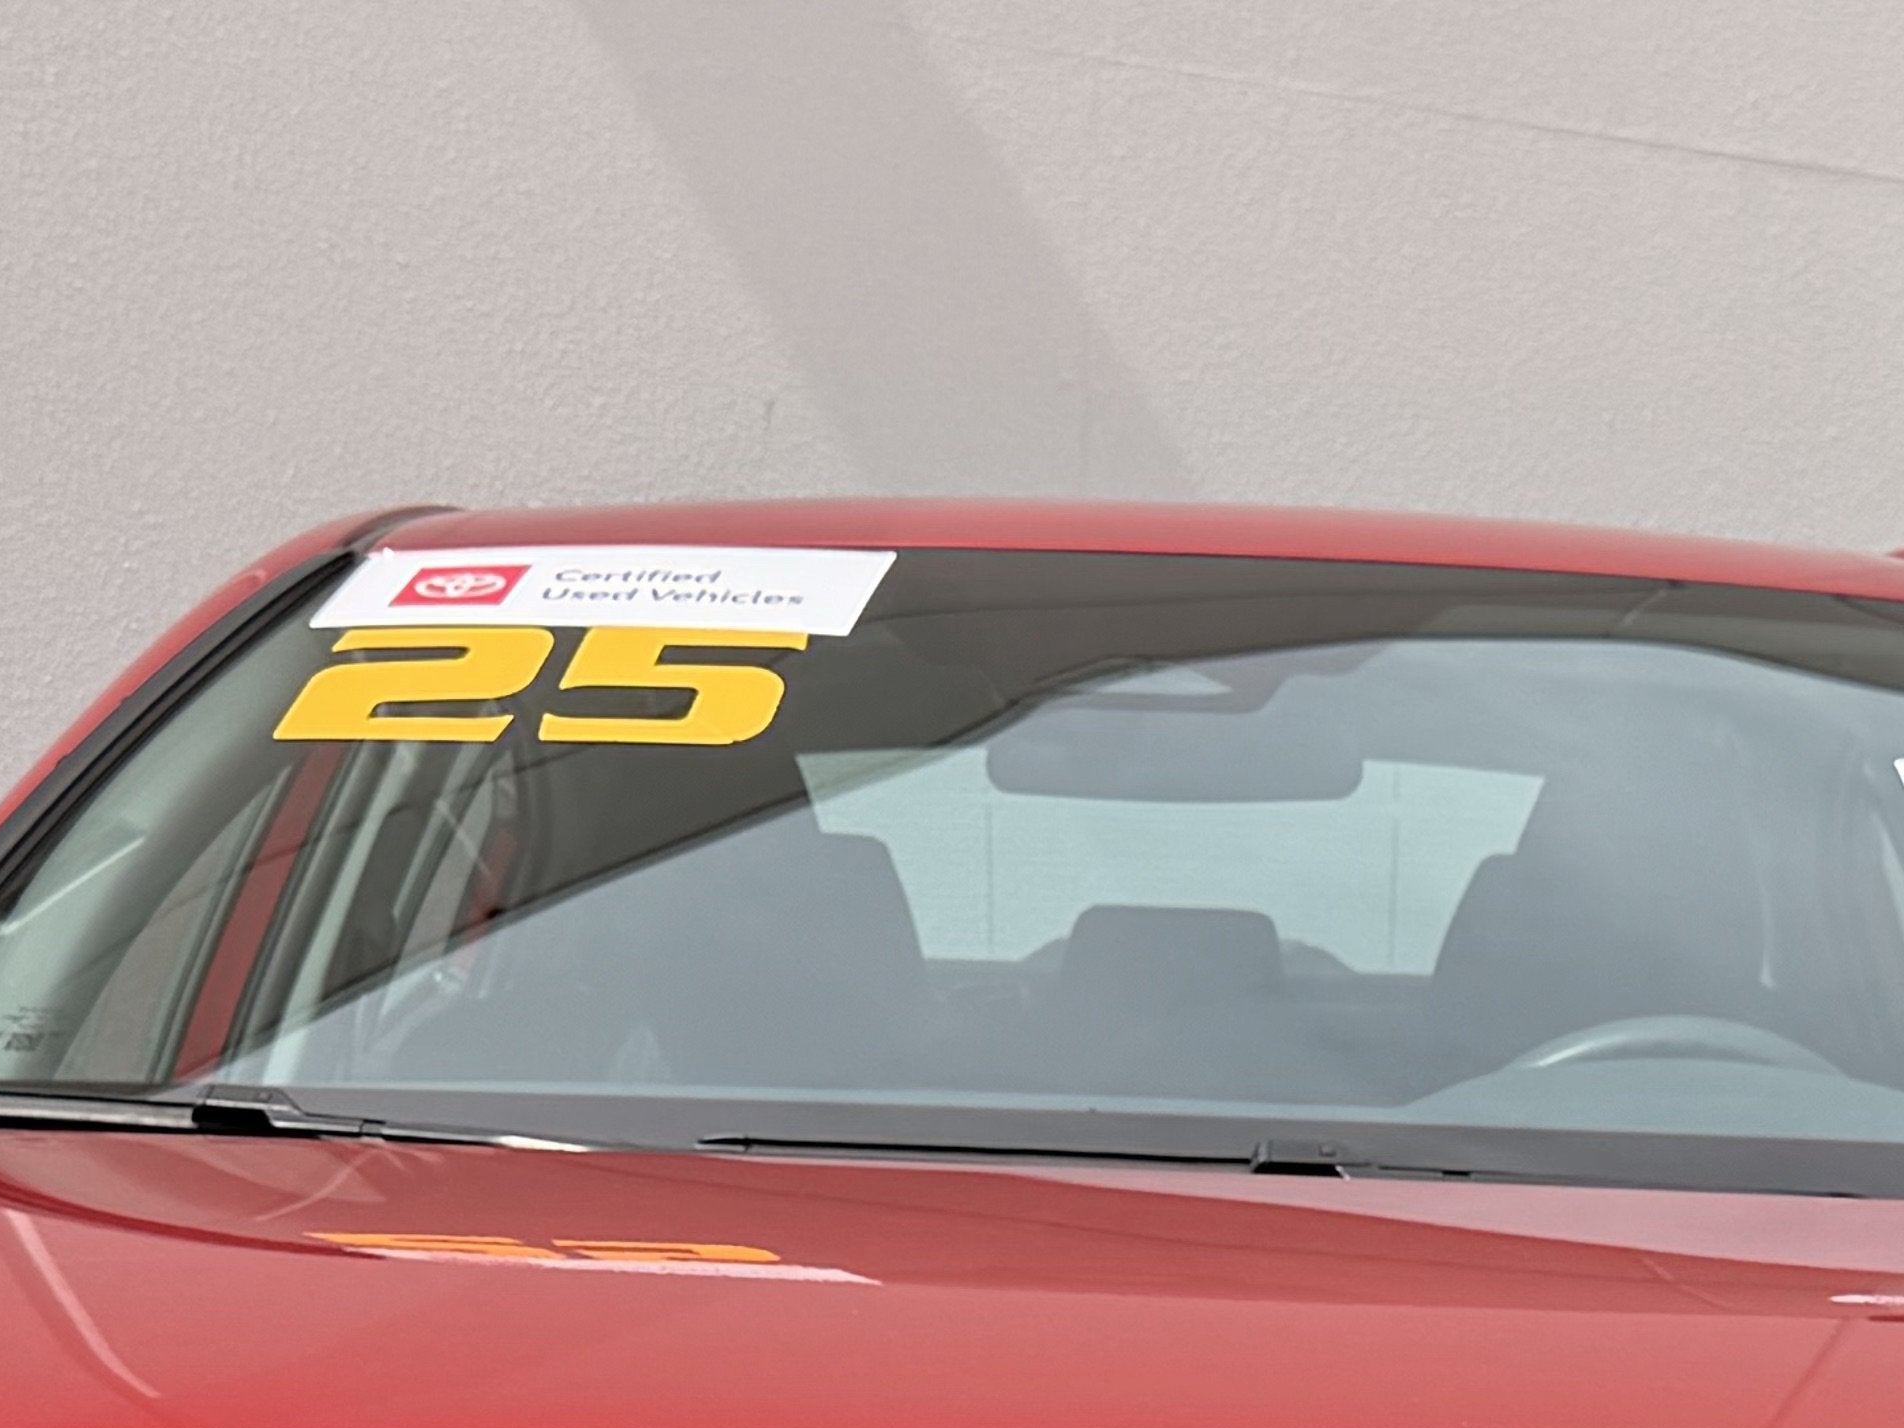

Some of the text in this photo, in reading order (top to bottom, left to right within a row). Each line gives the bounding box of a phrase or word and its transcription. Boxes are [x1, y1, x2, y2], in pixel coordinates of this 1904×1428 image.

[555, 570, 721, 583] Certified
[542, 587, 804, 605] Used Vehicles
[272, 627, 808, 744] 25
